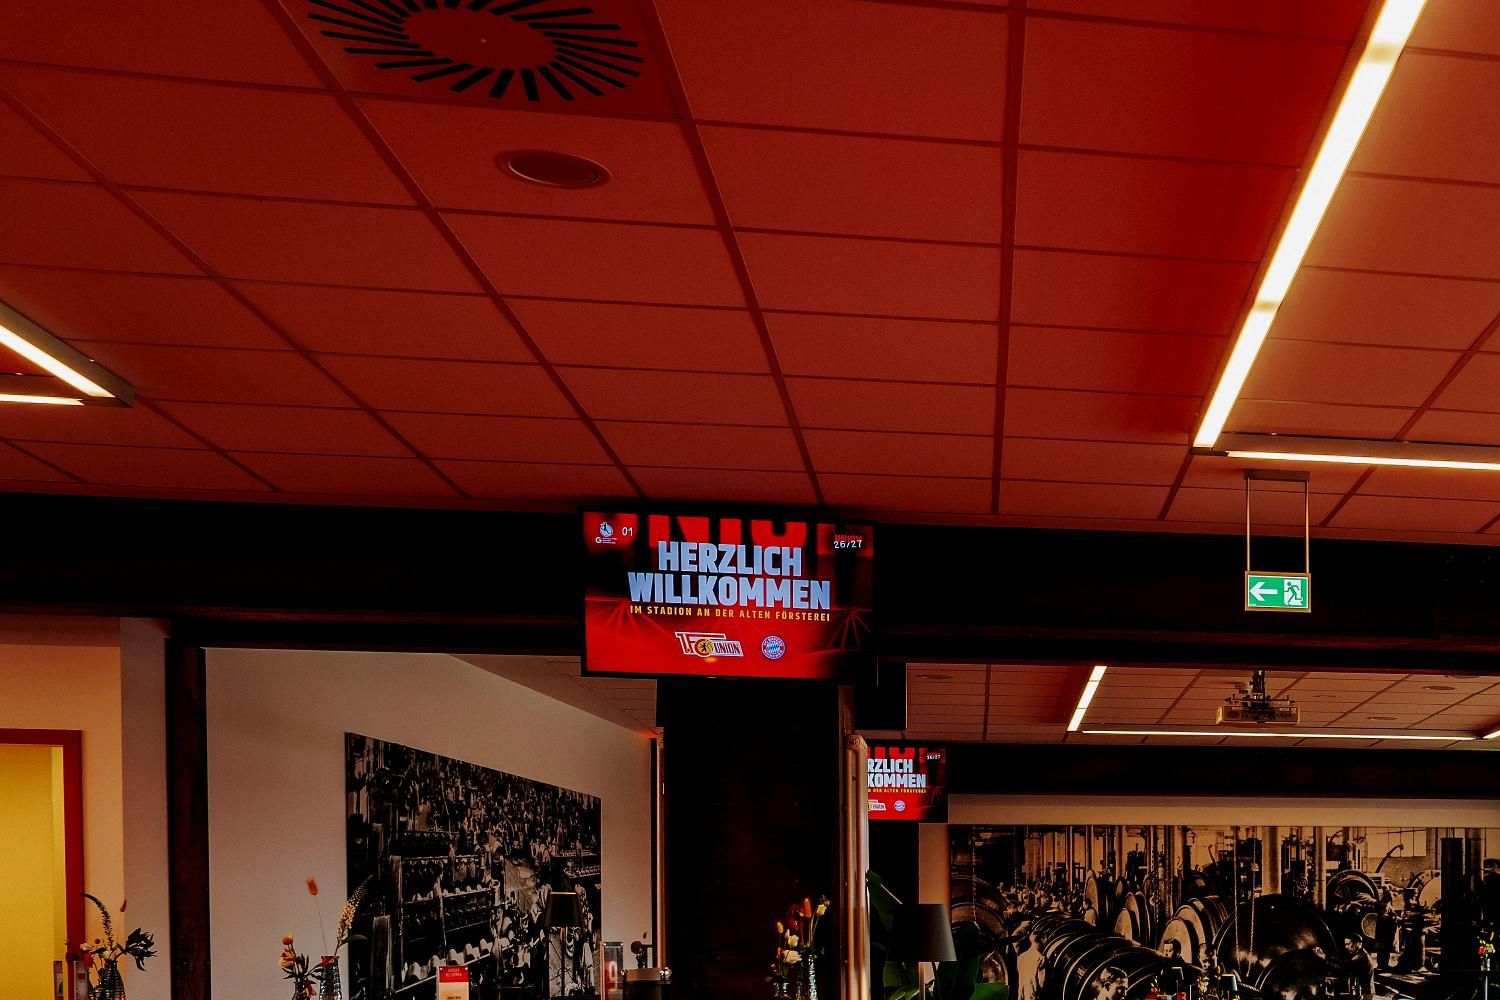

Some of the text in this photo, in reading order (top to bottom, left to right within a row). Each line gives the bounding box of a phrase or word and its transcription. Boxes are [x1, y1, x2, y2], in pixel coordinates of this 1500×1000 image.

[833, 539, 863, 549] 26/27
[657, 540, 803, 578] HERZLICH
[627, 571, 831, 610] WILLKOMMEN
[630, 605, 831, 622] IM STADION AN DER ALTEN FÖRSTEREI
